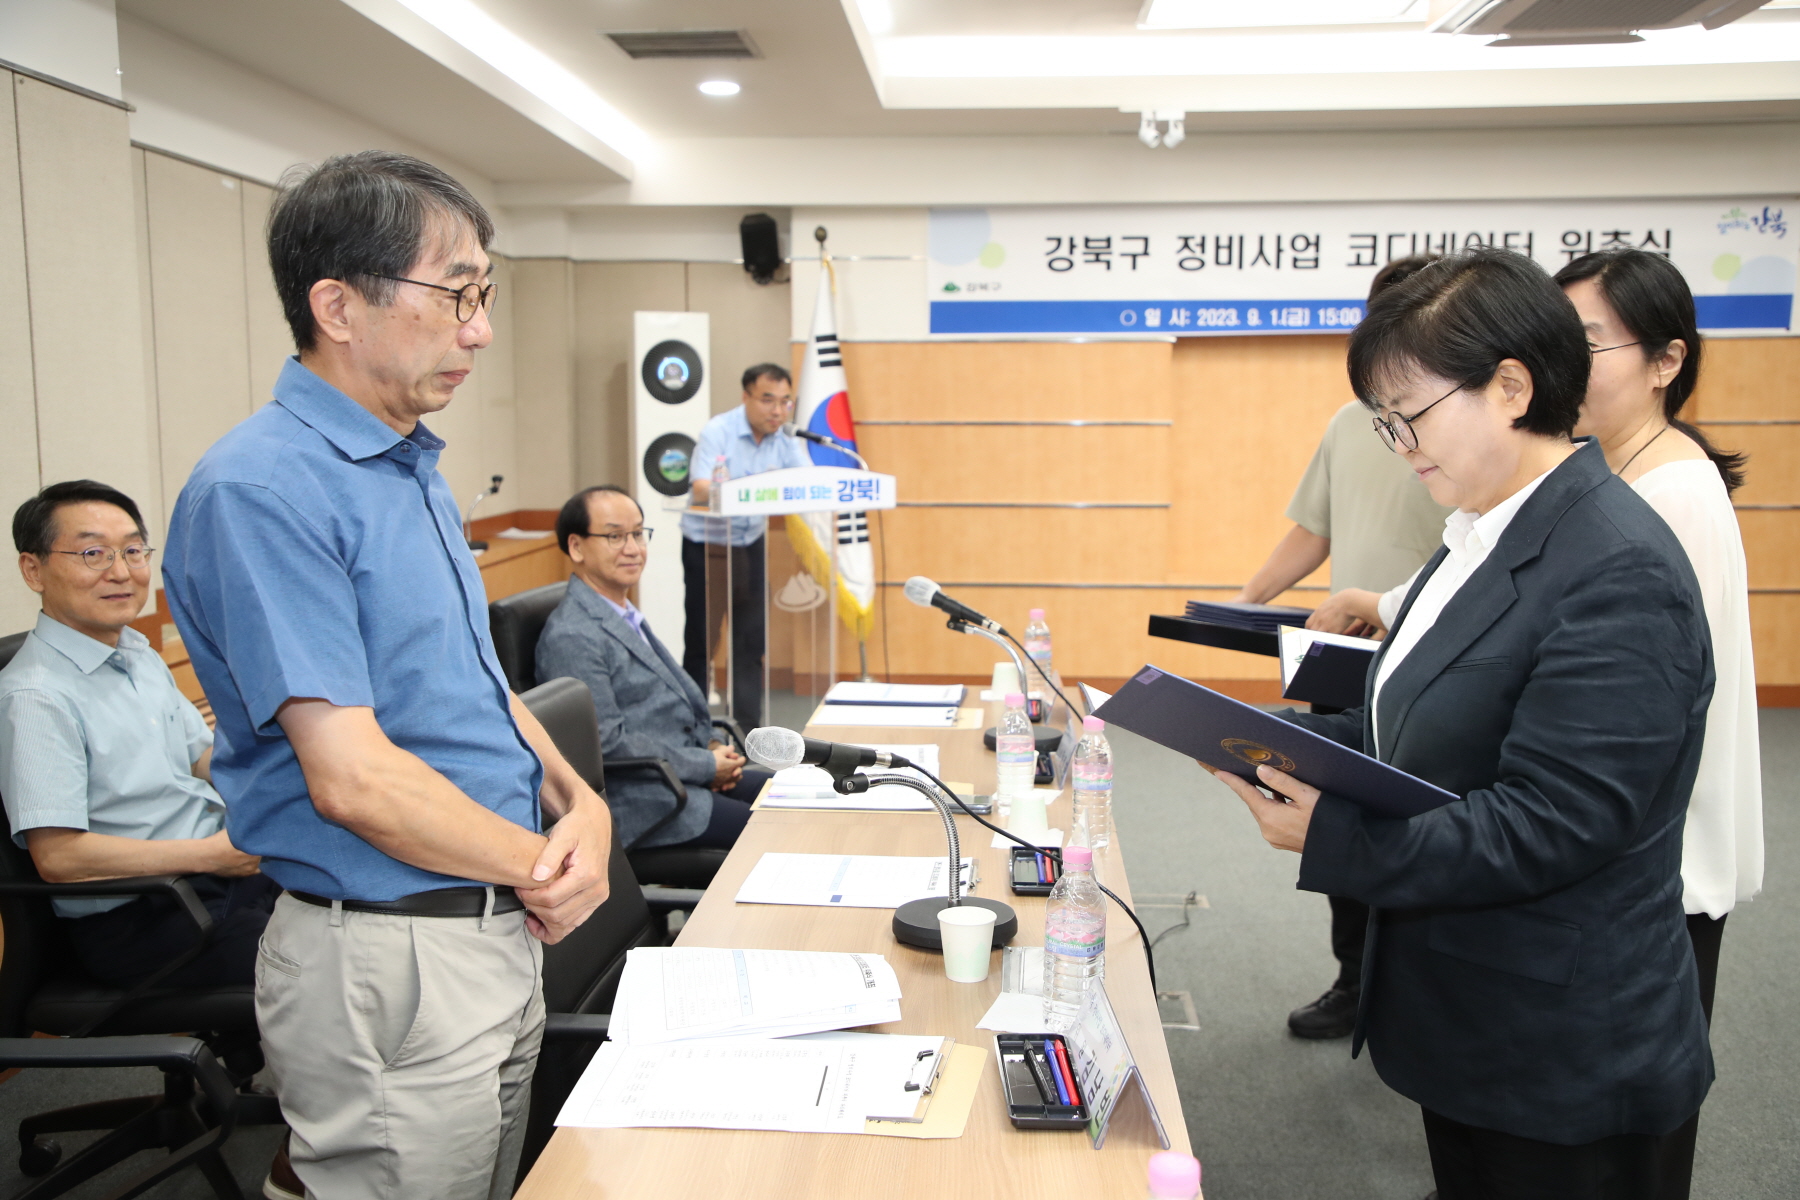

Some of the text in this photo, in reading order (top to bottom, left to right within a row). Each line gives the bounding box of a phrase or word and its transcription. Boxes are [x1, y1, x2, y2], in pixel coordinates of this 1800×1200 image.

[1750, 206, 1788, 239] 강북
[1045, 234, 1150, 272] 강북구
[1176, 233, 1320, 271] 정비사업
[1144, 308, 1161, 327] 일
[1197, 308, 1241, 326] 2023.
[1247, 308, 1263, 326] 9.
[1318, 307, 1362, 326] 15:00
[738, 488, 750, 502] 내
[783, 486, 806, 500] 힘이
[809, 485, 832, 499] 되는
[838, 479, 880, 502] 강북!
